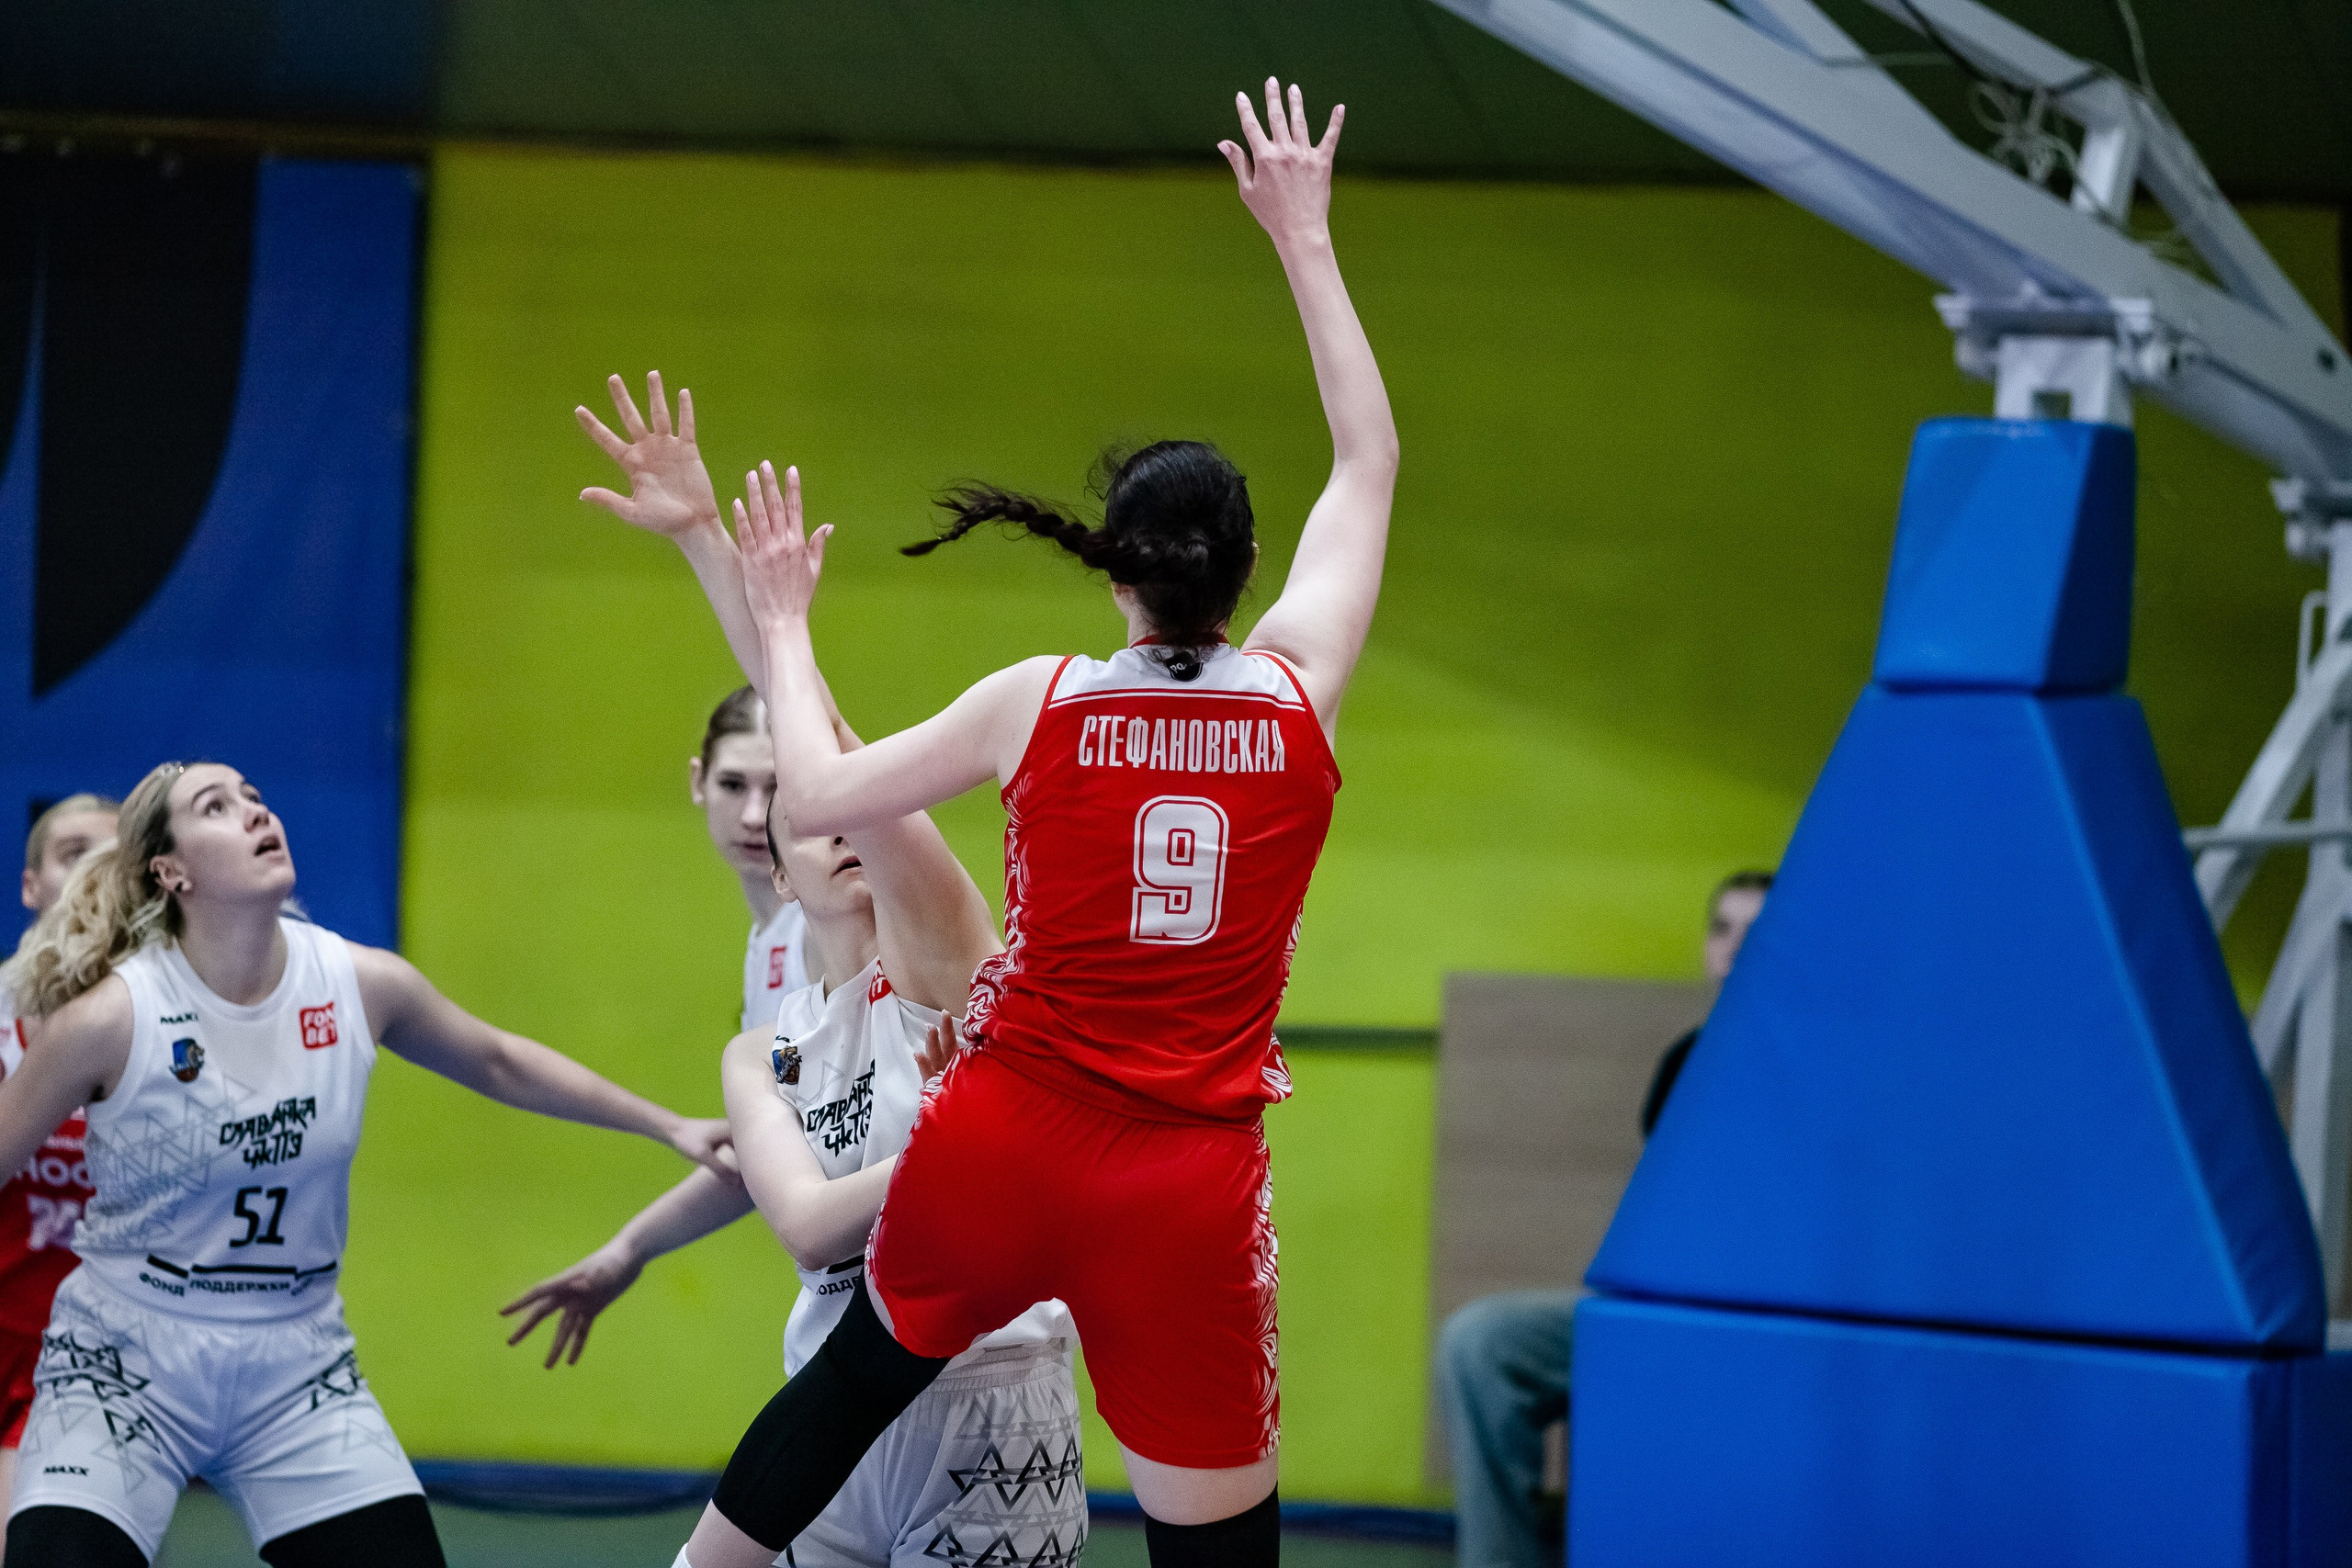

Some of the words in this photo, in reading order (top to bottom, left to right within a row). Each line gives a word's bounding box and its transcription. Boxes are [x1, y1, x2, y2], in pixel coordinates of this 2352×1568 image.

[1078, 715, 1285, 773] СТЕФАНОВСКАЯ
[1129, 795, 1229, 946] 9
[230, 1186, 288, 1247] 51
[139, 1272, 185, 1297] ФОНД
[189, 1280, 290, 1294] ПОДДЕРЖКИ
